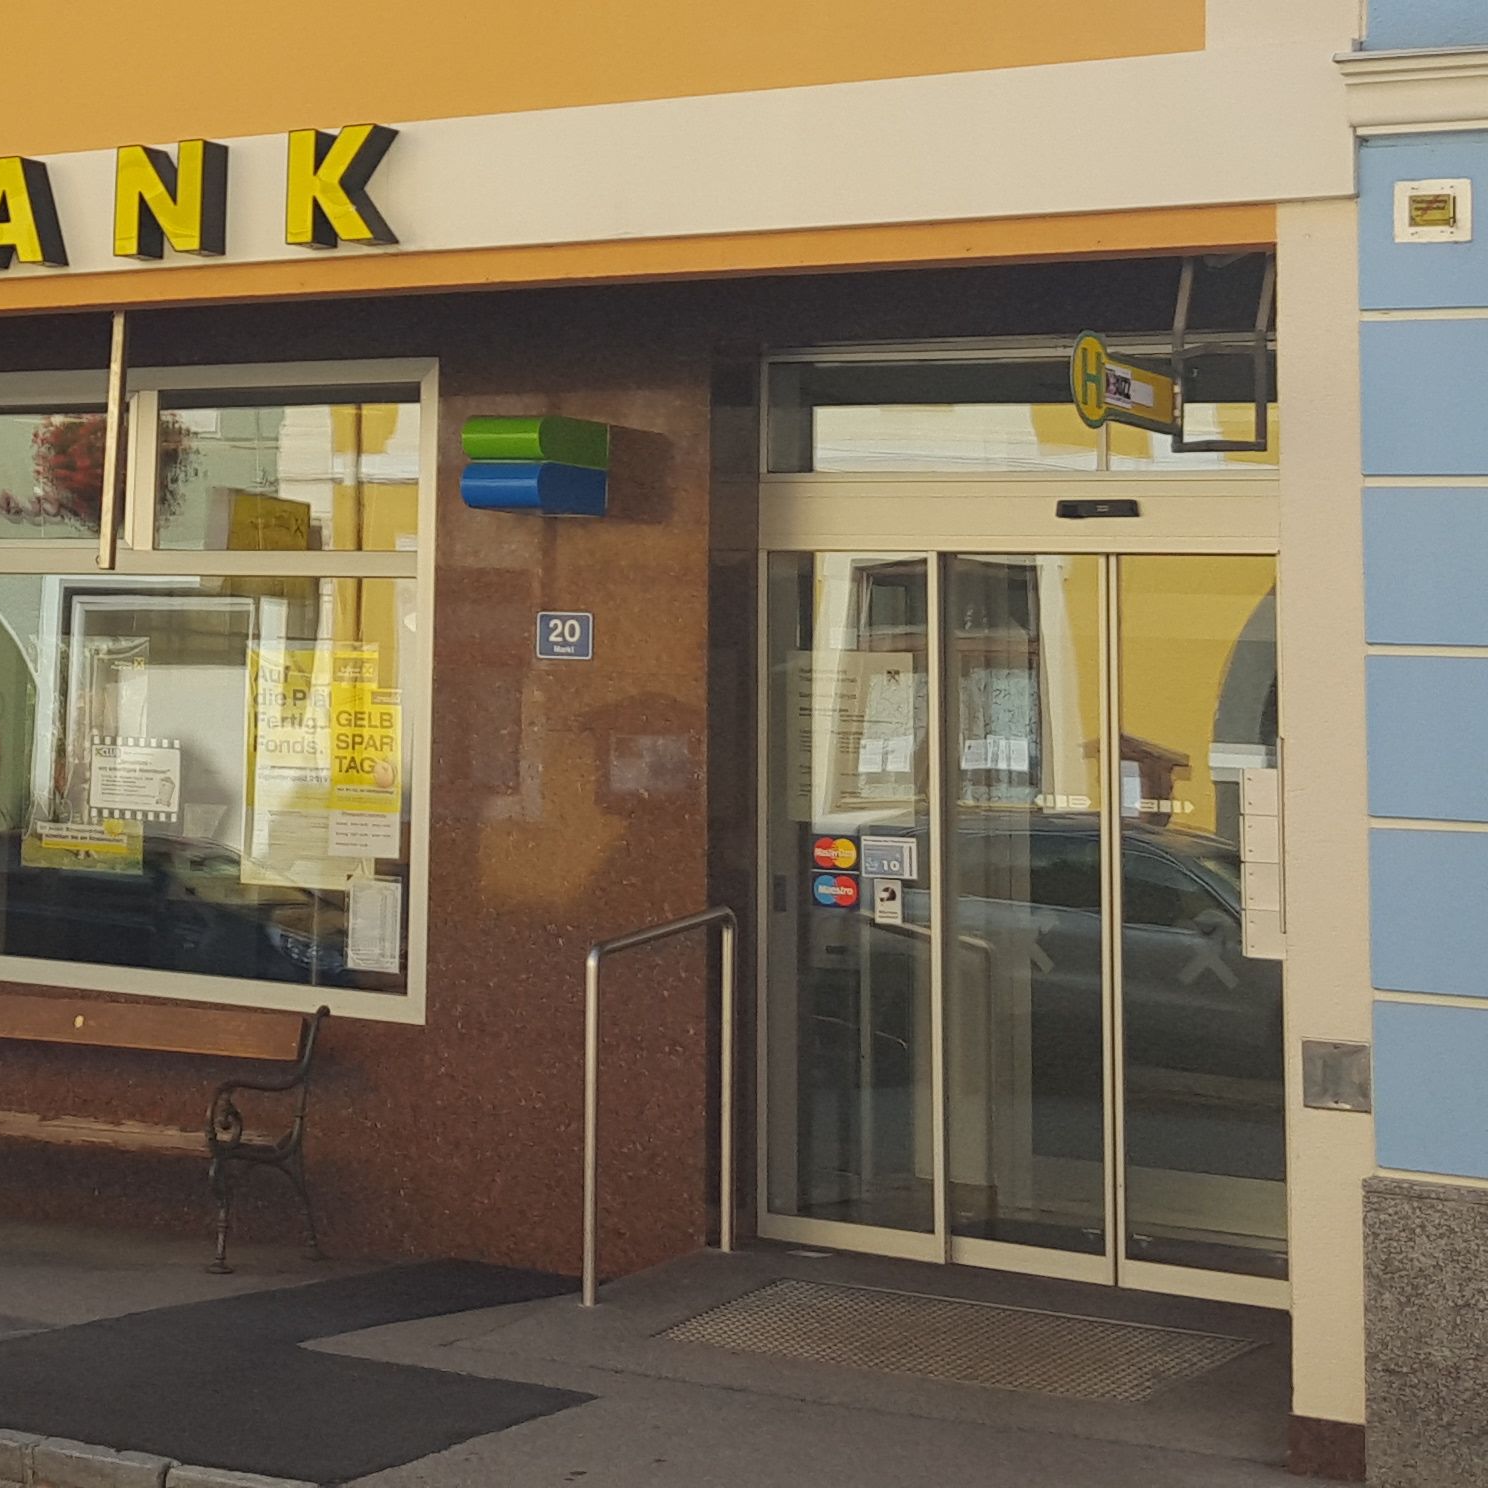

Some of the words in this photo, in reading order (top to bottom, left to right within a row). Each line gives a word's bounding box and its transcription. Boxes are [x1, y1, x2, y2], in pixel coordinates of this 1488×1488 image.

[1081, 347, 1104, 410] H
[548, 618, 581, 642] 20
[335, 710, 394, 730] GELB
[335, 732, 395, 753] SPAR
[817, 883, 854, 896] Maestro
